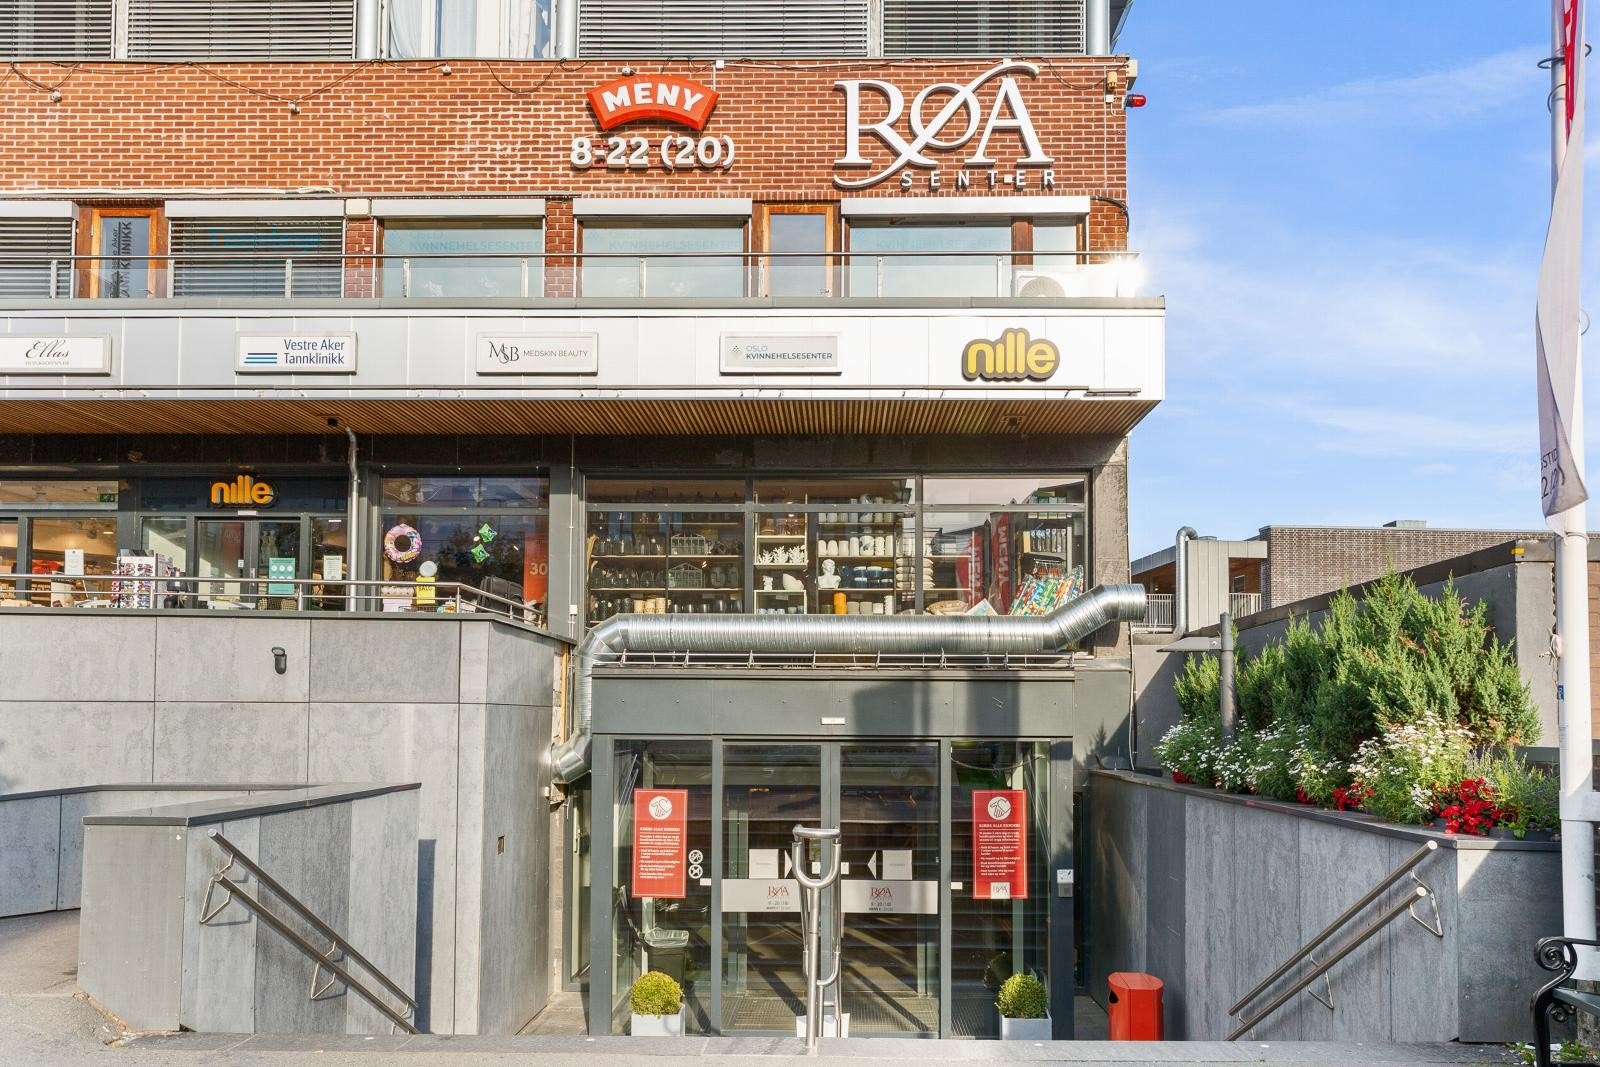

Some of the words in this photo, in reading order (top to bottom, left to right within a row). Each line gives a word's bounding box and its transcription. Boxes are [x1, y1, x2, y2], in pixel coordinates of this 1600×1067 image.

[602, 81, 704, 114] MENY
[833, 60, 1055, 190] RØA
[570, 135, 650, 170] 8-22
[660, 134, 736, 171] (20)
[900, 169, 1056, 188] SENTER
[25, 338, 70, 359] Ellas
[283, 339, 317, 351] Vestre
[320, 339, 345, 351] Aker
[966, 331, 1057, 376] nille
[283, 352, 345, 365] Tannklinikk
[746, 352, 833, 360] KVINNEHELSESENTER
[210, 474, 273, 506] nille
[529, 562, 548, 576] 30
[871, 886, 893, 899] RØA
